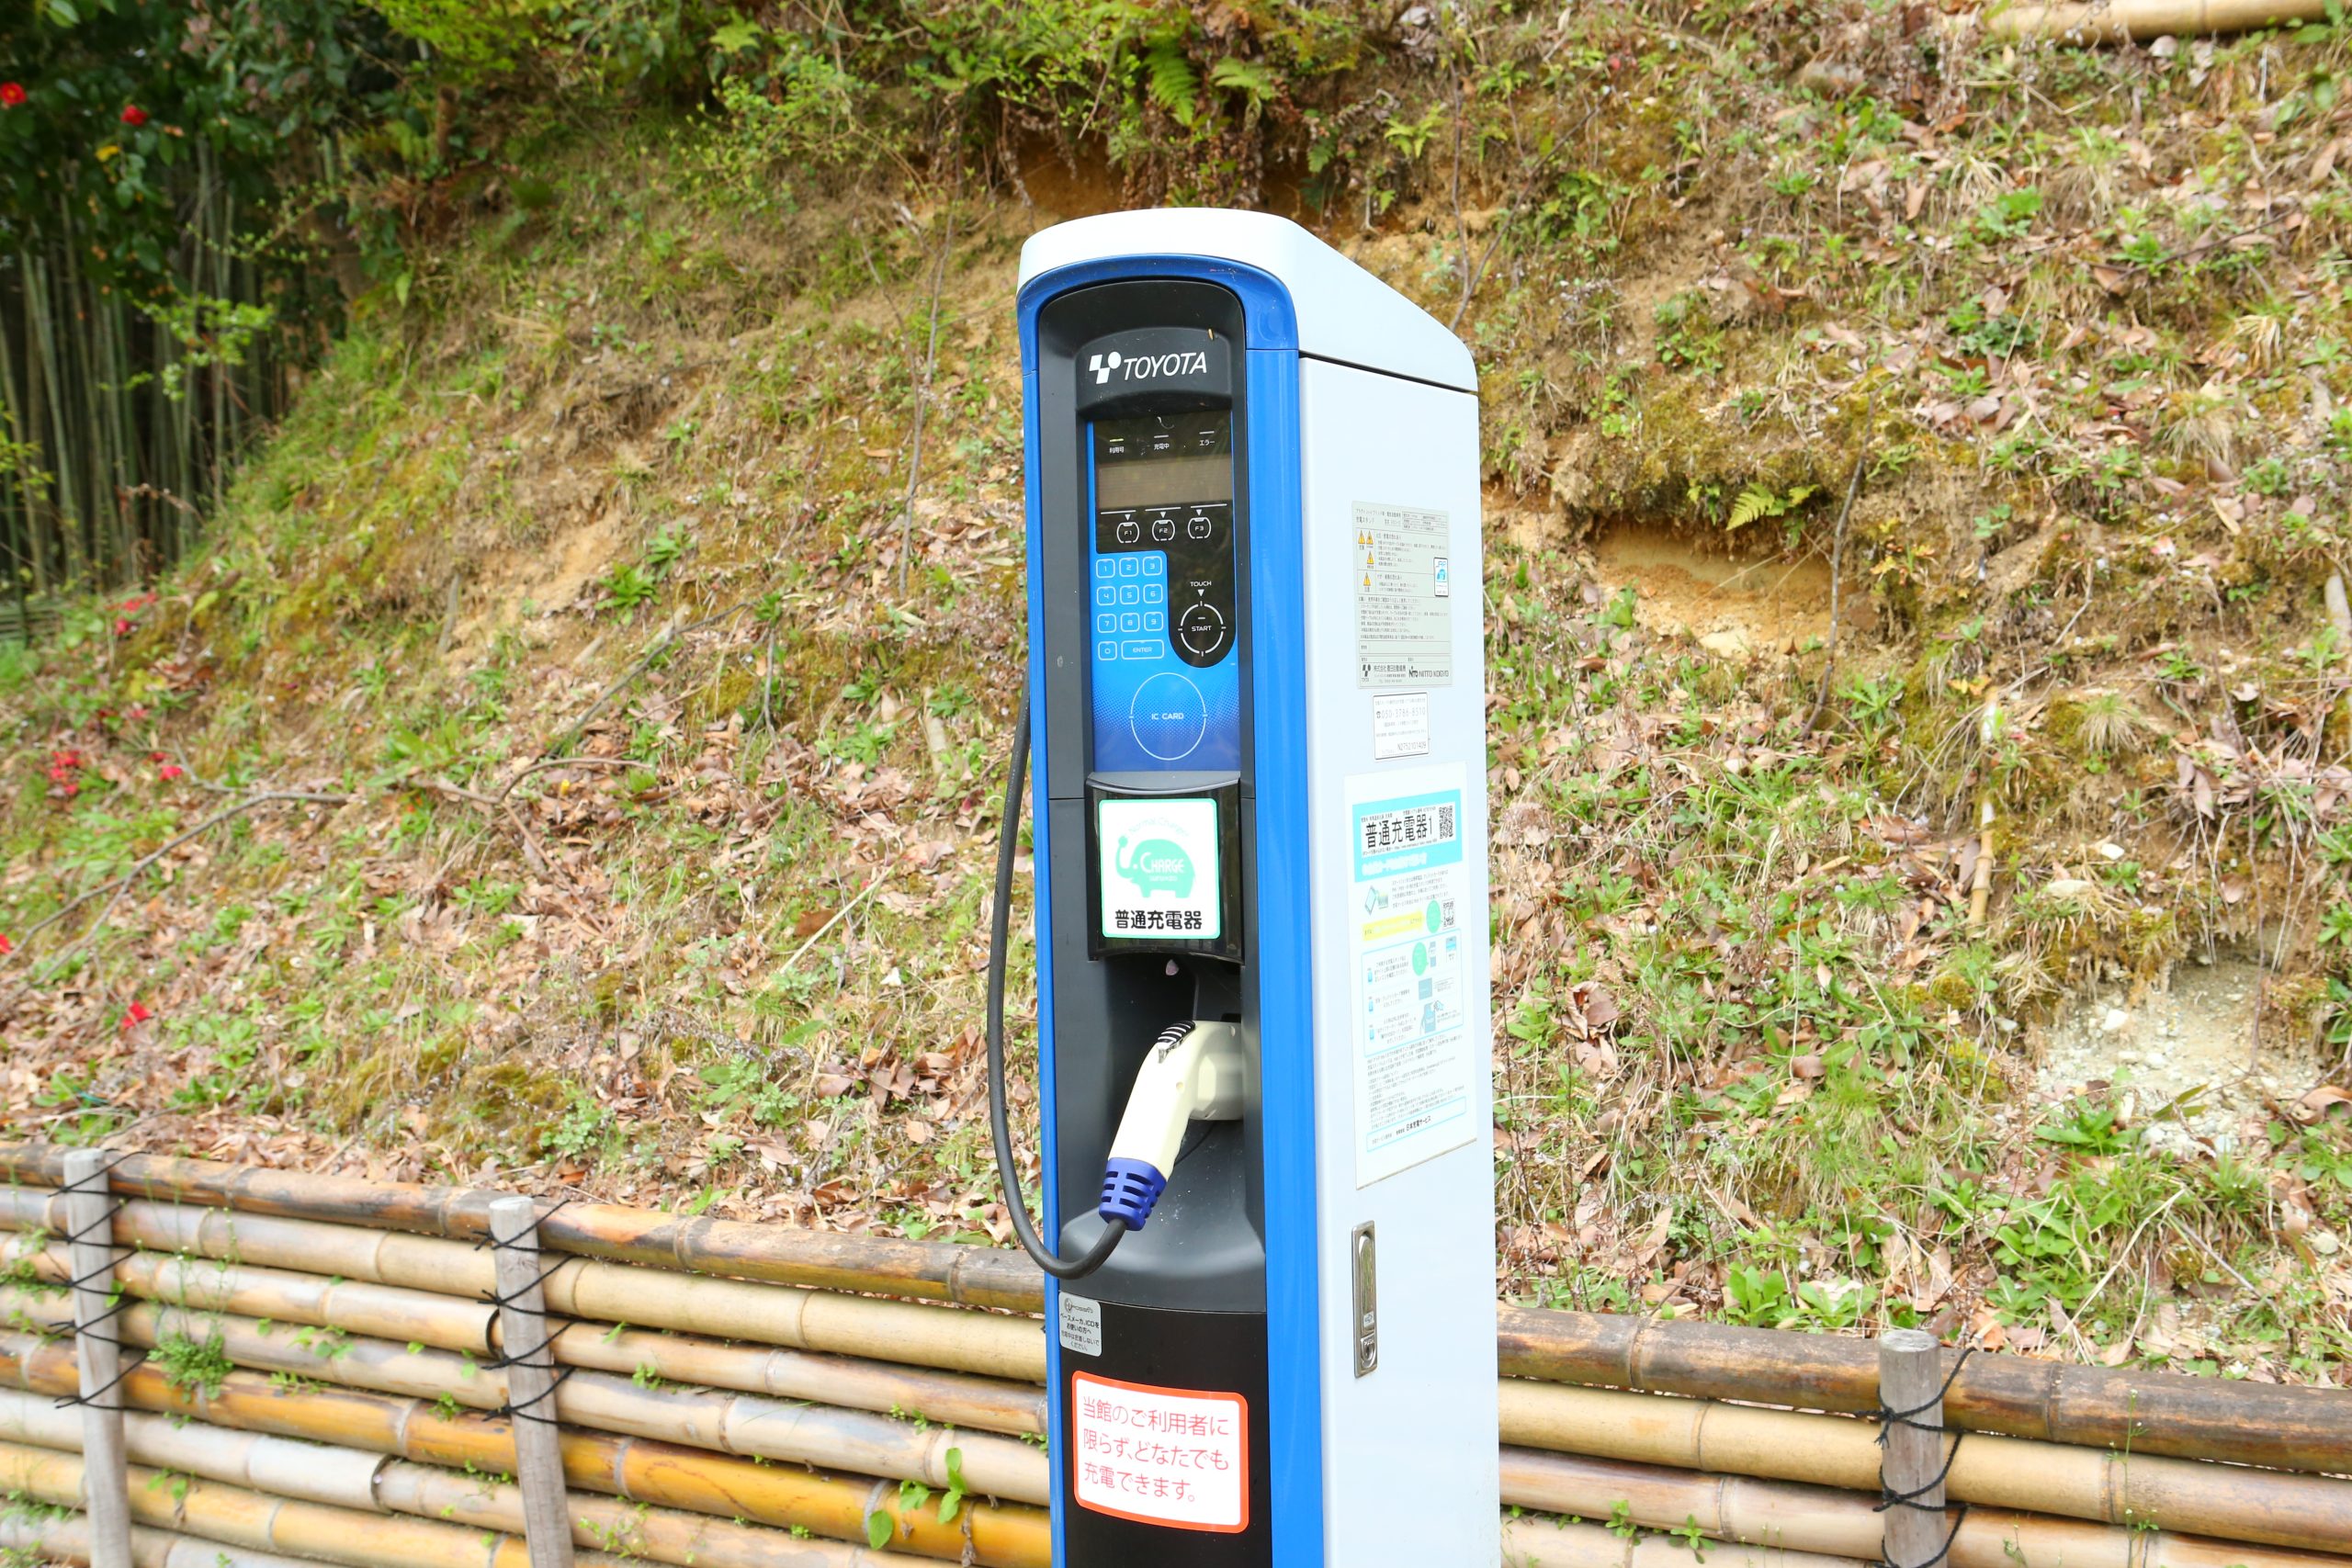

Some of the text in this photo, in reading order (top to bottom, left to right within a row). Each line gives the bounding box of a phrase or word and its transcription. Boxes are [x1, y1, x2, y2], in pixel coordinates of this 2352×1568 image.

[1123, 351, 1207, 381] TOYOTA
[1115, 909, 1202, 930] 普通充電器
[1083, 1396, 1229, 1436] 当館のご利用者に
[1084, 1428, 1229, 1471] 限らず、どなたでも
[1084, 1461, 1195, 1502] 充電できます。
